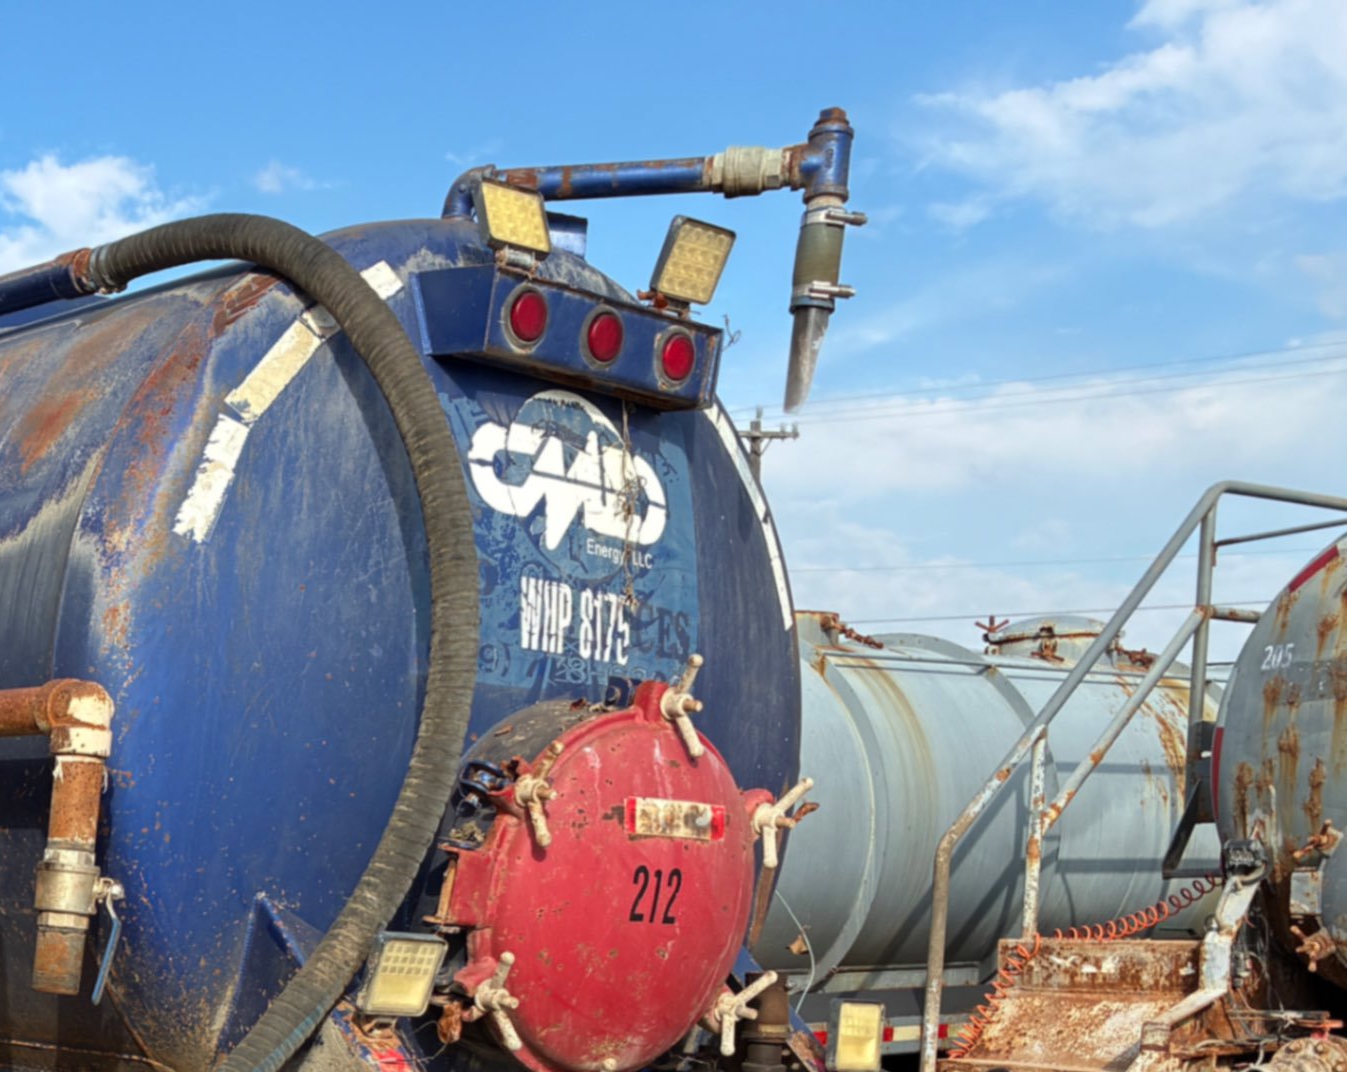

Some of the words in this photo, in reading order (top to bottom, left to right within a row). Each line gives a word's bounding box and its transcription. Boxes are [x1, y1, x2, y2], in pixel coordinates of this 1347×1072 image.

[586, 539, 625, 567] Energy
[631, 548, 653, 570] LLC
[520, 575, 573, 654] WHP
[1260, 643, 1295, 671] 205
[629, 865, 682, 924] 212
